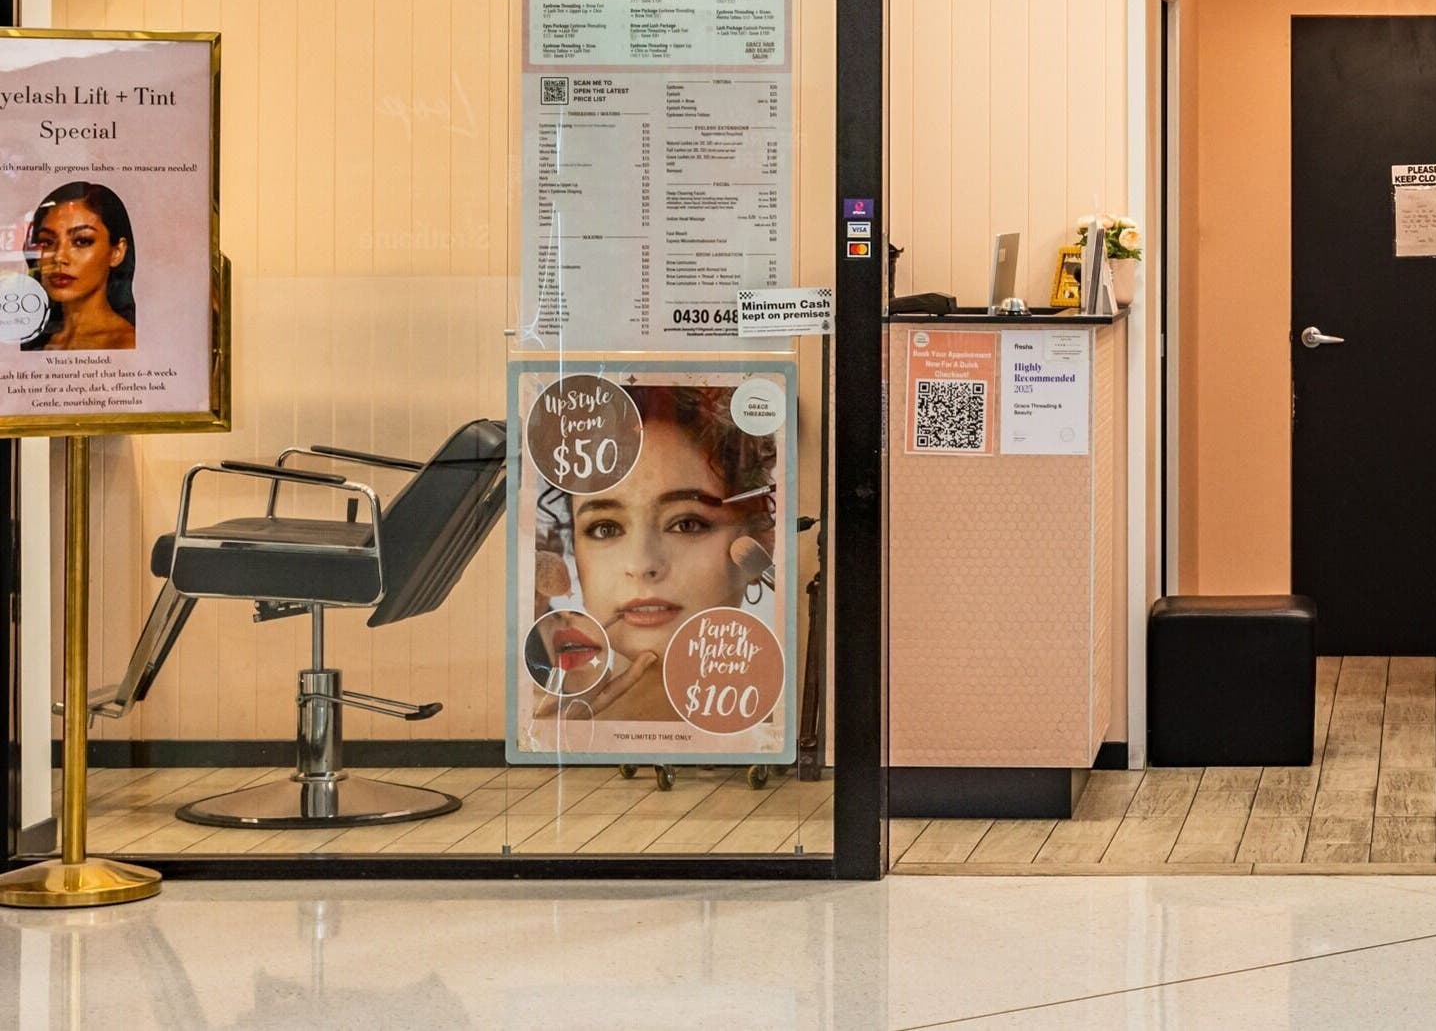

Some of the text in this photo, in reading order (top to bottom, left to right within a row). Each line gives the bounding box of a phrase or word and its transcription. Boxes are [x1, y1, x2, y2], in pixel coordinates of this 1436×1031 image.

[0, 86, 176, 109] yelash Lift + Tint
[40, 120, 116, 145] Special
[16, 163, 51, 173] naturally
[54, 165, 89, 173] gorgeous
[92, 163, 114, 171] lashes
[168, 164, 197, 172] needed!
[0, 293, 41, 313] 80
[742, 300, 796, 310] Minimum
[800, 299, 830, 308] Cash
[673, 309, 738, 324] 0430 648
[742, 312, 765, 321] kept
[783, 310, 830, 319] premises
[75, 356, 111, 364] Included:
[948, 351, 992, 359] Appointment
[31, 371, 42, 379] for
[52, 371, 80, 379] natural
[82, 370, 98, 378] curl
[101, 370, 116, 378] that
[118, 370, 135, 378] lasts
[154, 368, 177, 376] weeks
[1014, 363, 1041, 373] Highly
[1014, 374, 1075, 382] Recommended
[7, 386, 26, 394] Lash
[45, 385, 57, 393] for
[66, 384, 86, 395] deep,
[89, 384, 109, 392] dark,
[111, 383, 146, 392] effortless
[149, 382, 166, 391] look
[1014, 385, 1033, 393] 2025
[32, 397, 143, 408] Gentle, nourishing formulas
[544, 390, 612, 416] UpStyle
[560, 416, 606, 439] from
[553, 438, 618, 484] $50
[699, 618, 752, 640] Party
[688, 636, 762, 658] MakeUp
[700, 654, 748, 675] from
[685, 679, 759, 718] $100
